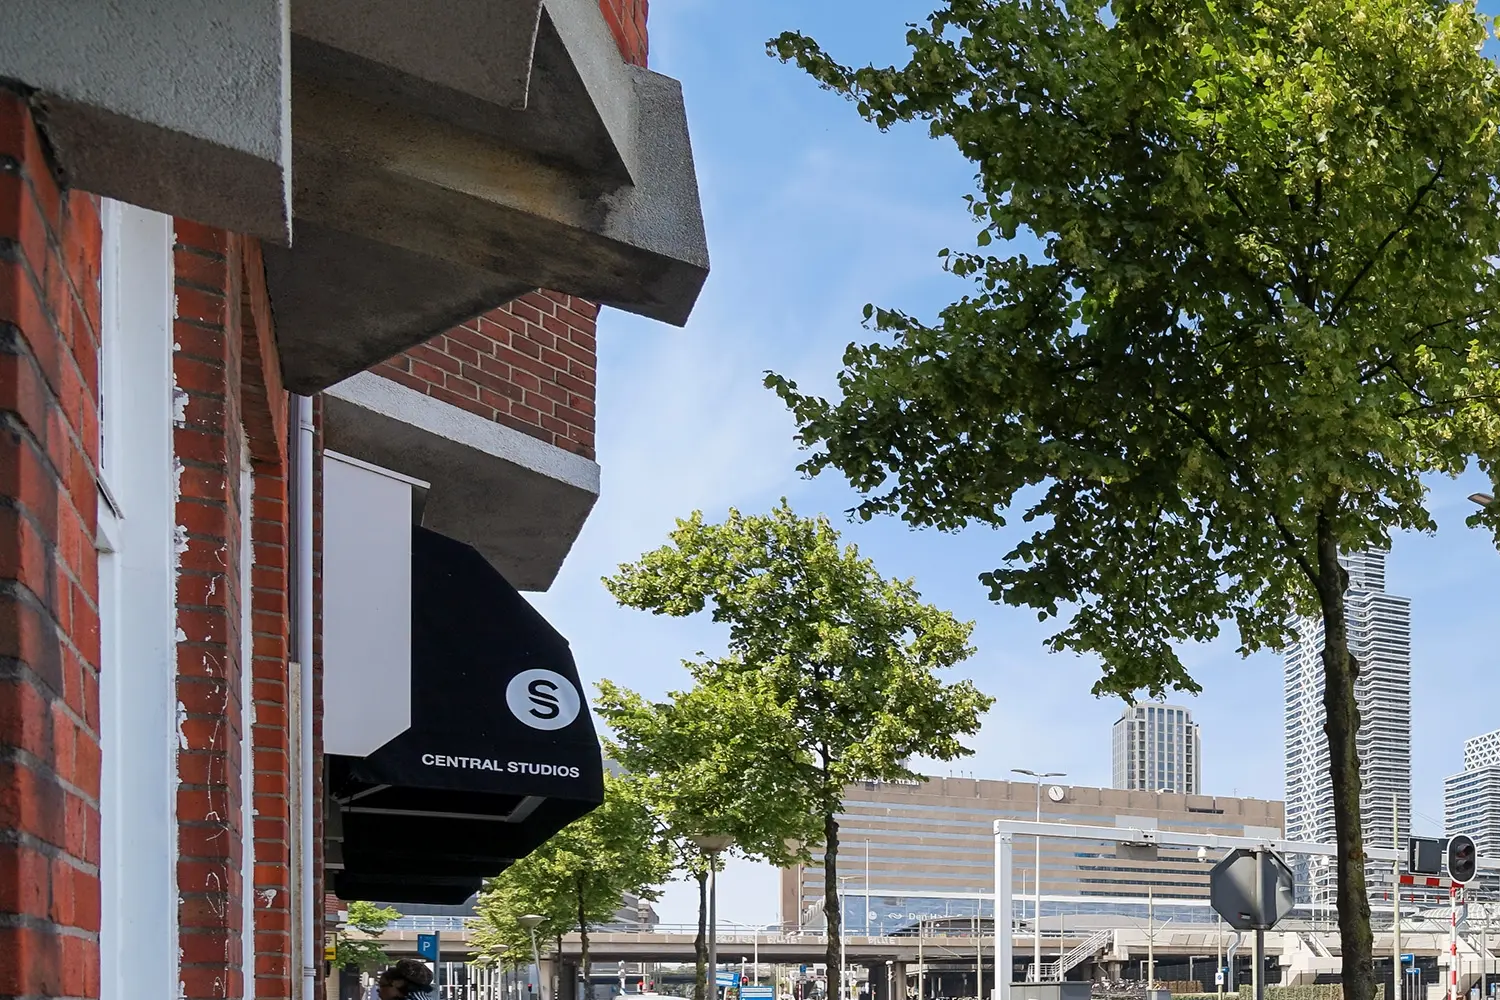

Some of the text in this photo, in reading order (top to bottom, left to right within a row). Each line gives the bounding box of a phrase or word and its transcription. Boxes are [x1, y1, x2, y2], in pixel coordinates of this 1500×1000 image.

[528, 679, 560, 720] S
[421, 753, 580, 778] CENTRAL STUDIOS
[423, 941, 431, 952] P
